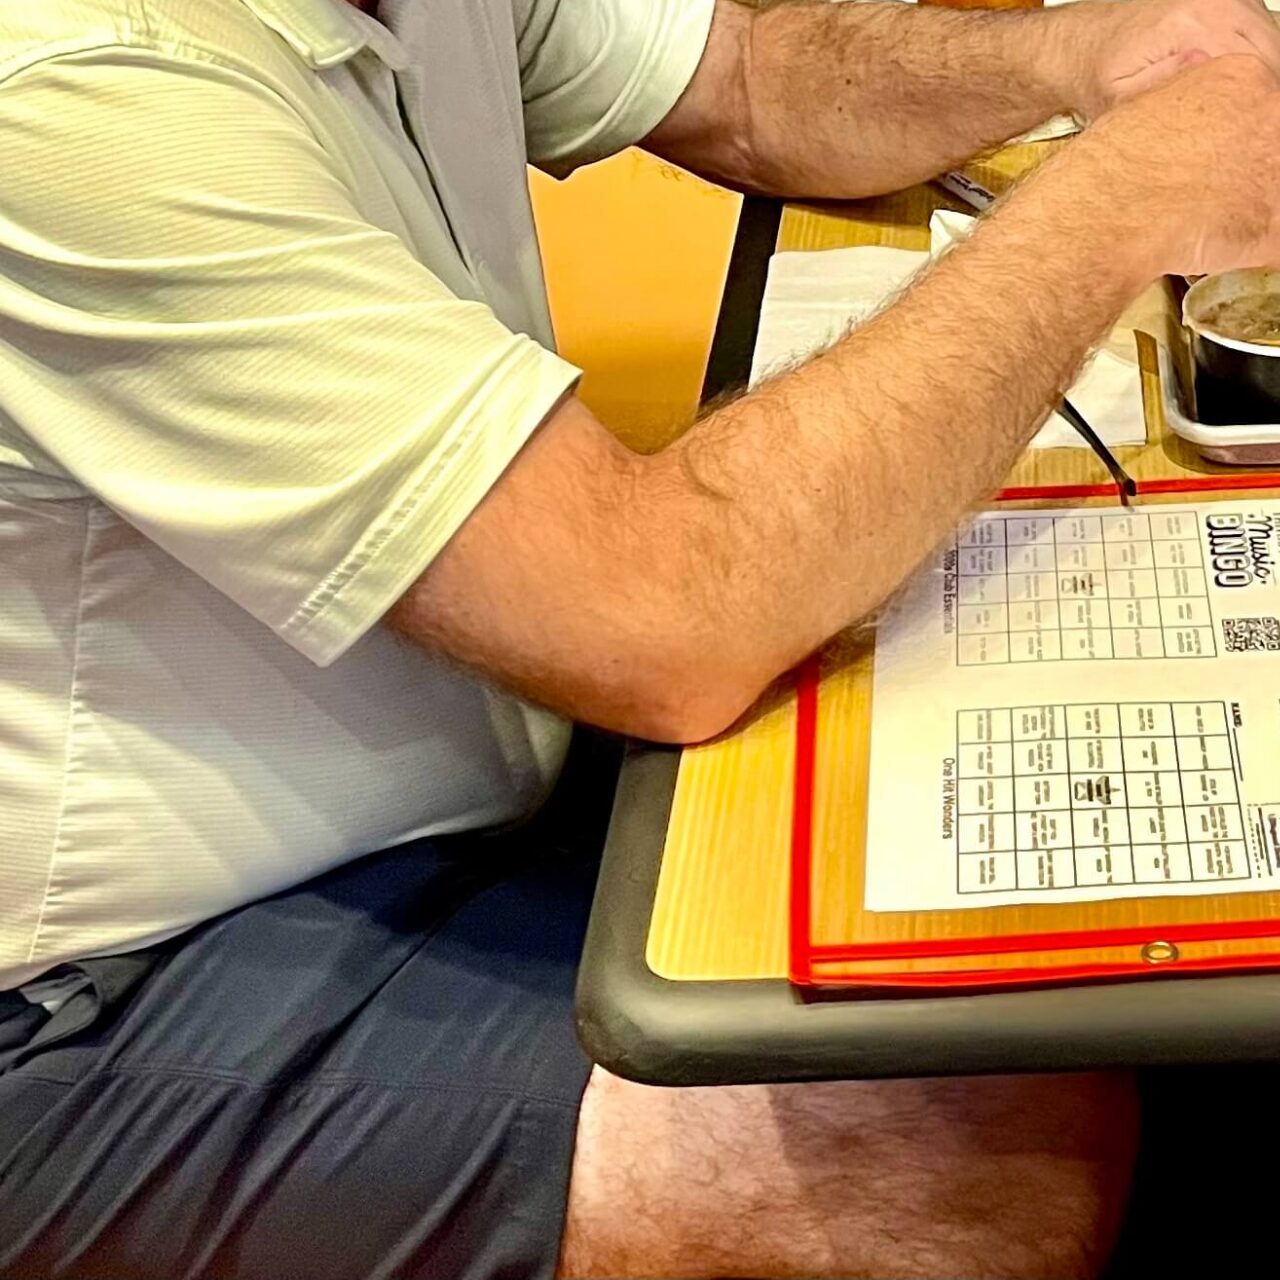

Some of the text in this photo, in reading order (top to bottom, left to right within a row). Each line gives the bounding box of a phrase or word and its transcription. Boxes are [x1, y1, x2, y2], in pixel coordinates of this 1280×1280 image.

[1206, 513, 1253, 587] BINGO
[1246, 516, 1276, 578] Music
[942, 757, 956, 840] One Hit Wonders
